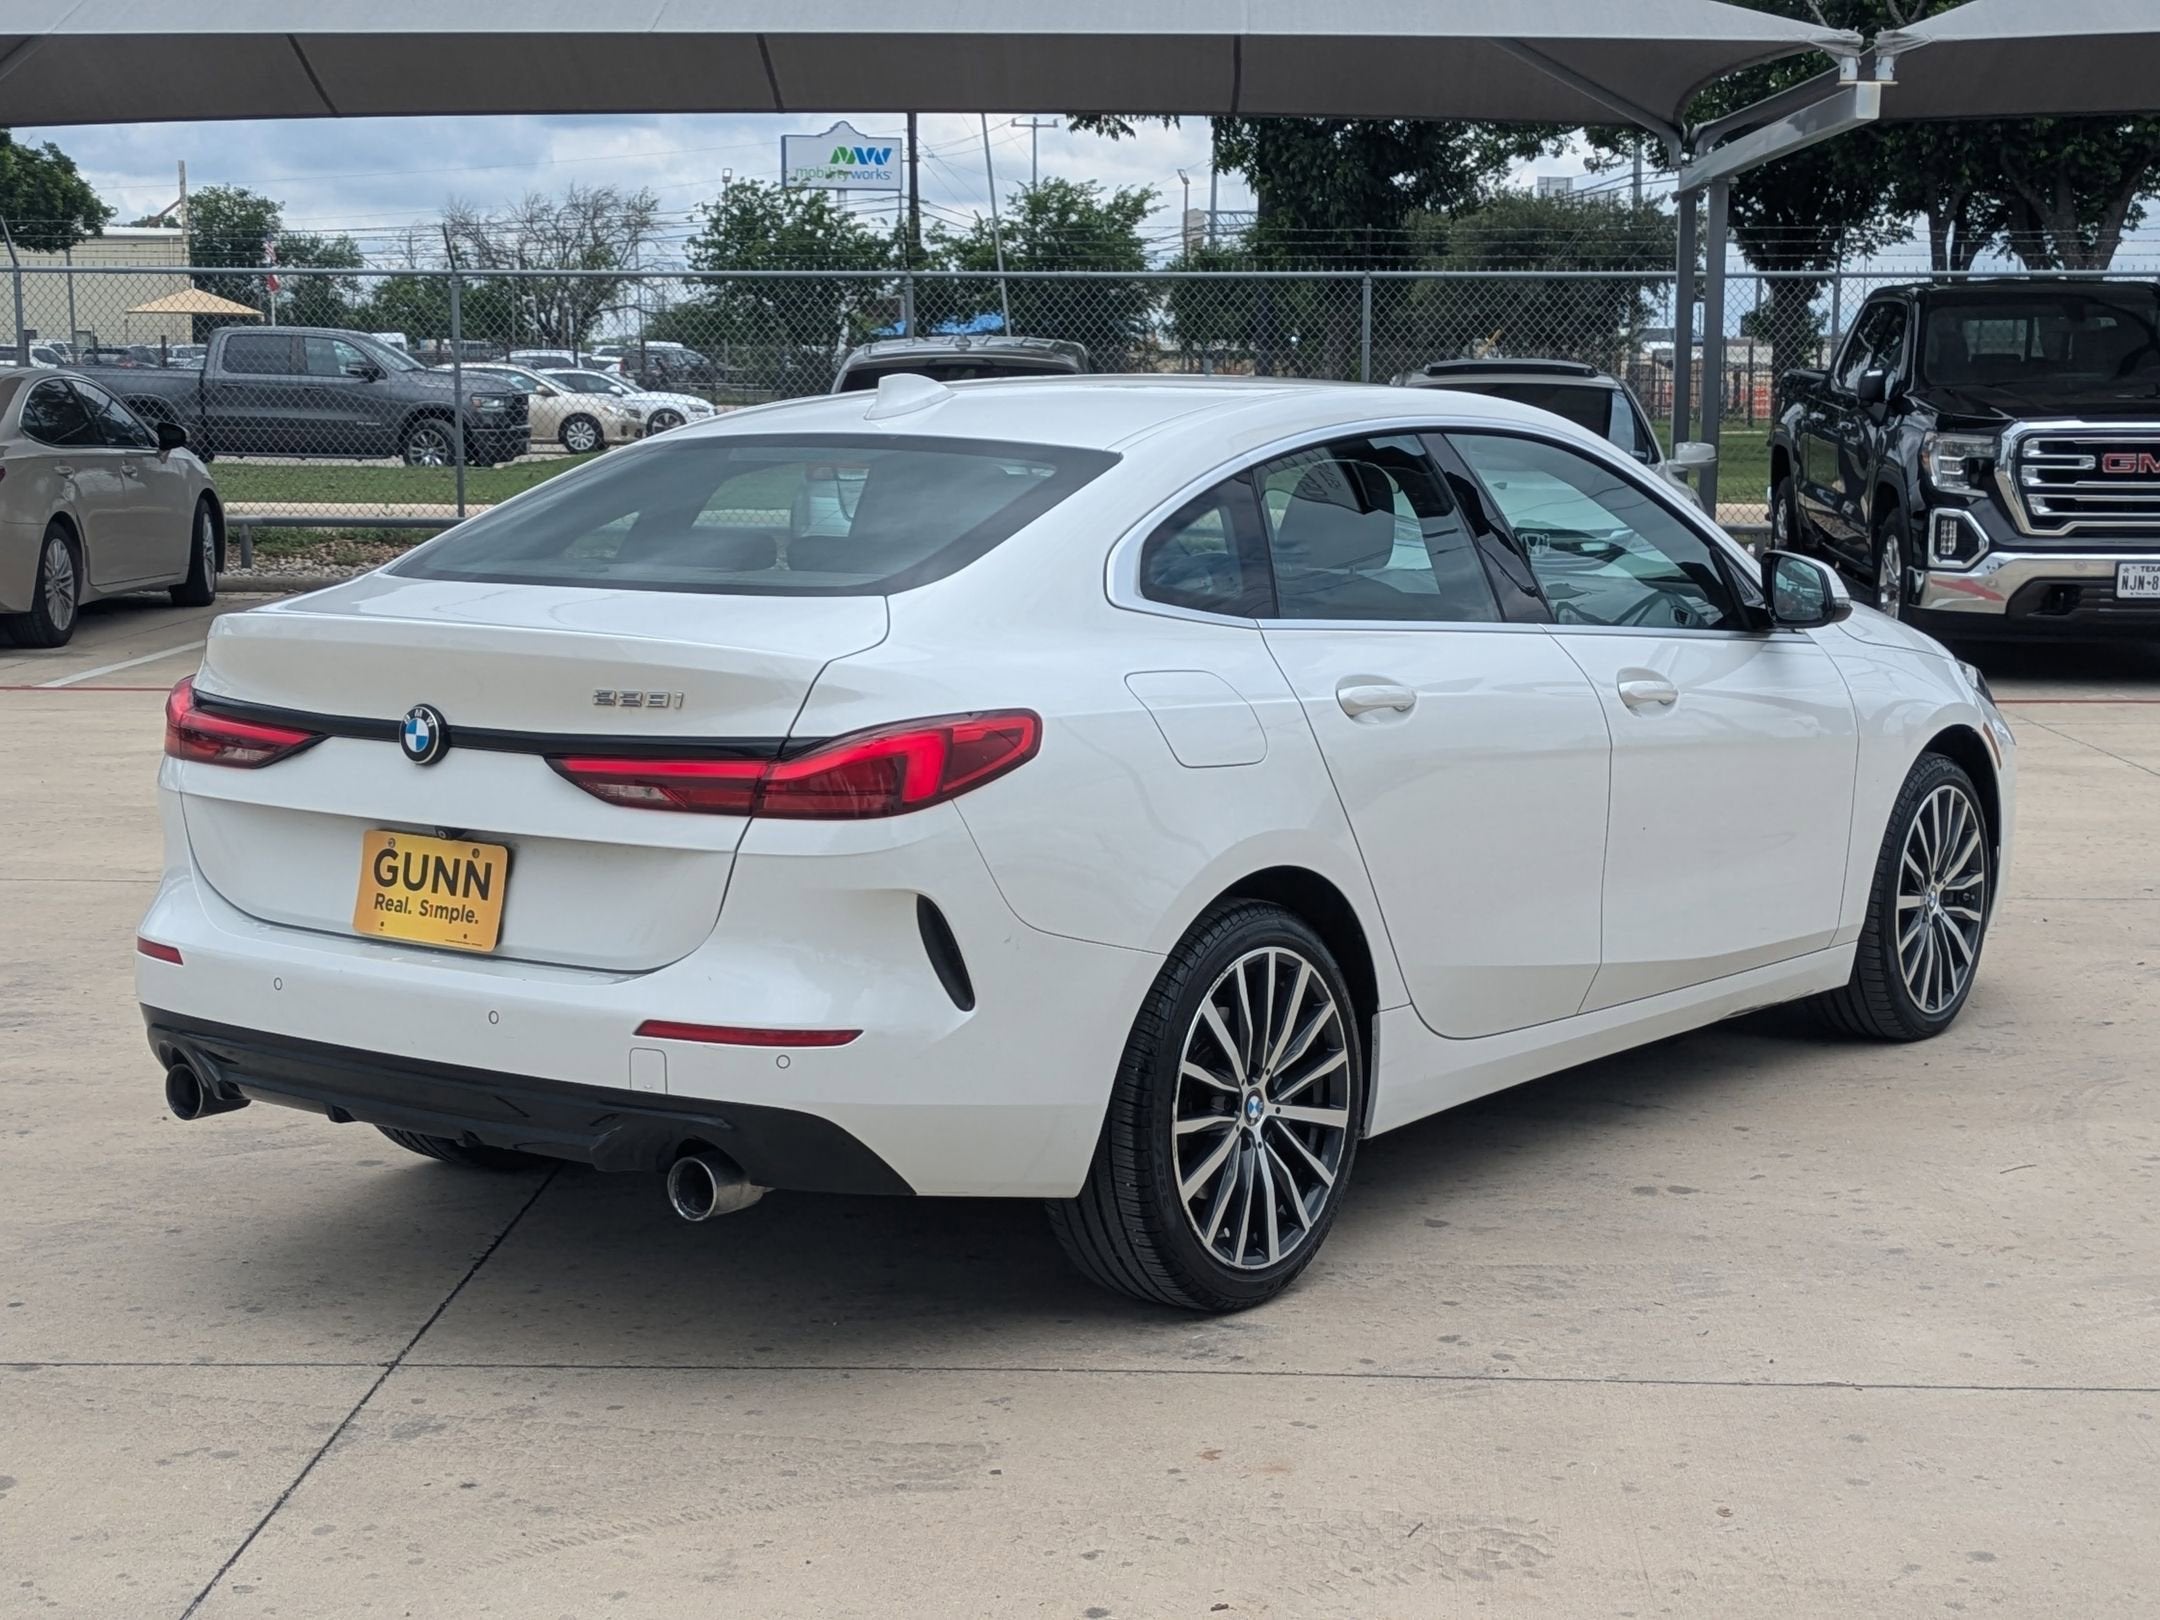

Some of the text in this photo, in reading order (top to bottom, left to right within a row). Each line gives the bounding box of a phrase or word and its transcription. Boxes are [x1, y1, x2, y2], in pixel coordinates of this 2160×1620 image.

[403, 708, 436, 728] BMW
[373, 848, 493, 901] GUNN
[373, 893, 412, 915] Real.
